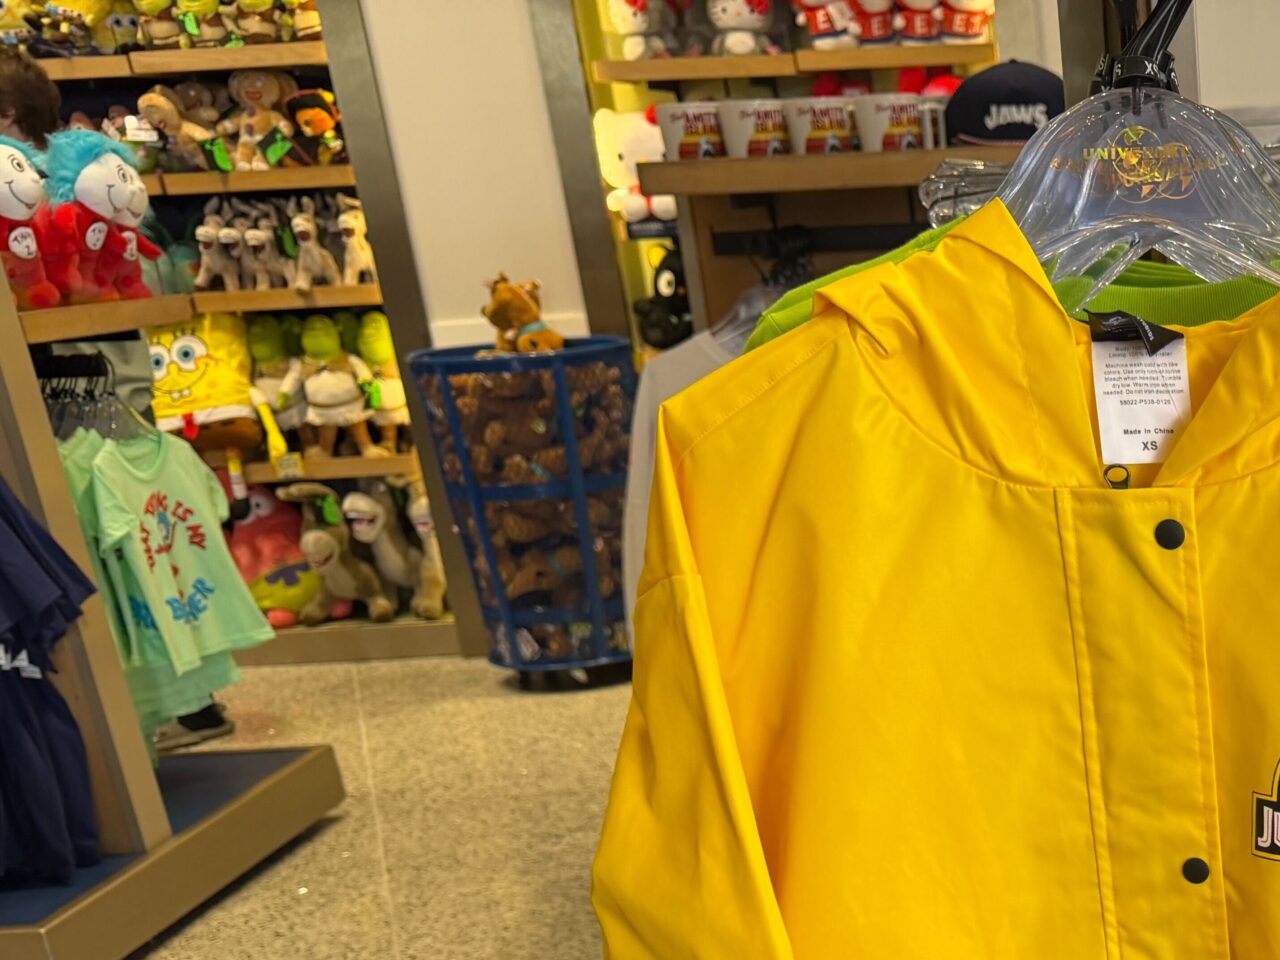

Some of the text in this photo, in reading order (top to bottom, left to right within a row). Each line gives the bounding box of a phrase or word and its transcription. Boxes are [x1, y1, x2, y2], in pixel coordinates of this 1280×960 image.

[984, 103, 1049, 131] JAWS
[1153, 427, 1175, 435] China
[1142, 440, 1159, 452] XS
